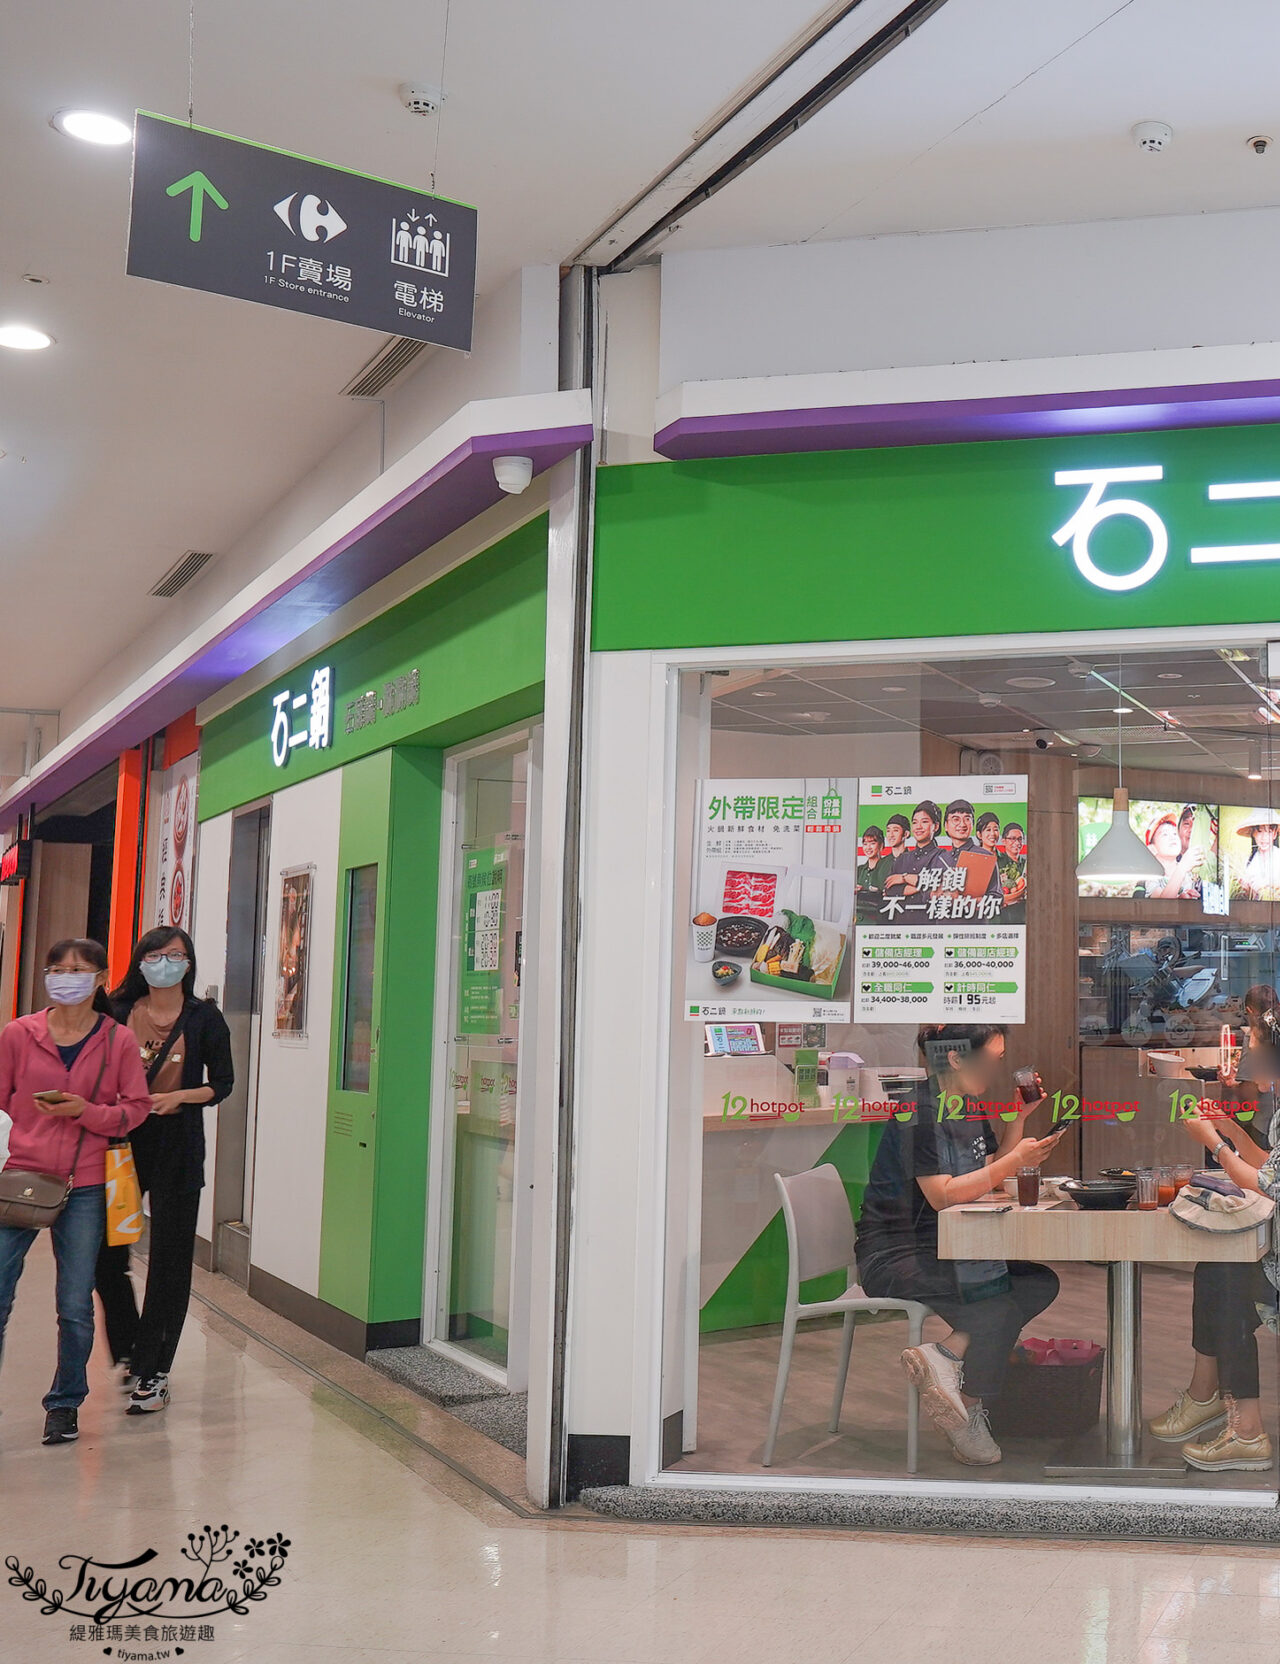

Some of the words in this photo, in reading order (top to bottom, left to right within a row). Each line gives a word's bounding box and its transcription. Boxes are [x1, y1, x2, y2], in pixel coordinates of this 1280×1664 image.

[266, 250, 353, 292] 1F賣場
[264, 275, 276, 285] 1F
[278, 278, 305, 293] Store
[307, 287, 350, 304] entrance
[394, 280, 444, 314] 電梯
[398, 307, 436, 324] Elevator
[270, 666, 333, 768] 石二鍋
[707, 795, 805, 821] 外帶限定
[805, 795, 818, 820] 組合
[916, 866, 968, 893] 解鎖
[879, 894, 1003, 921] 不一樣的你
[721, 1091, 749, 1123] 12
[750, 1098, 805, 1117] hotpot
[832, 1091, 860, 1123] 12
[861, 1099, 917, 1117] hotpot
[937, 1090, 965, 1122] 12
[966, 1098, 1023, 1117] hotpot
[1051, 1089, 1080, 1122] 12
[1081, 1098, 1140, 1117] hotpot
[1169, 1089, 1198, 1122] 12
[1199, 1098, 1260, 1117] hotpot
